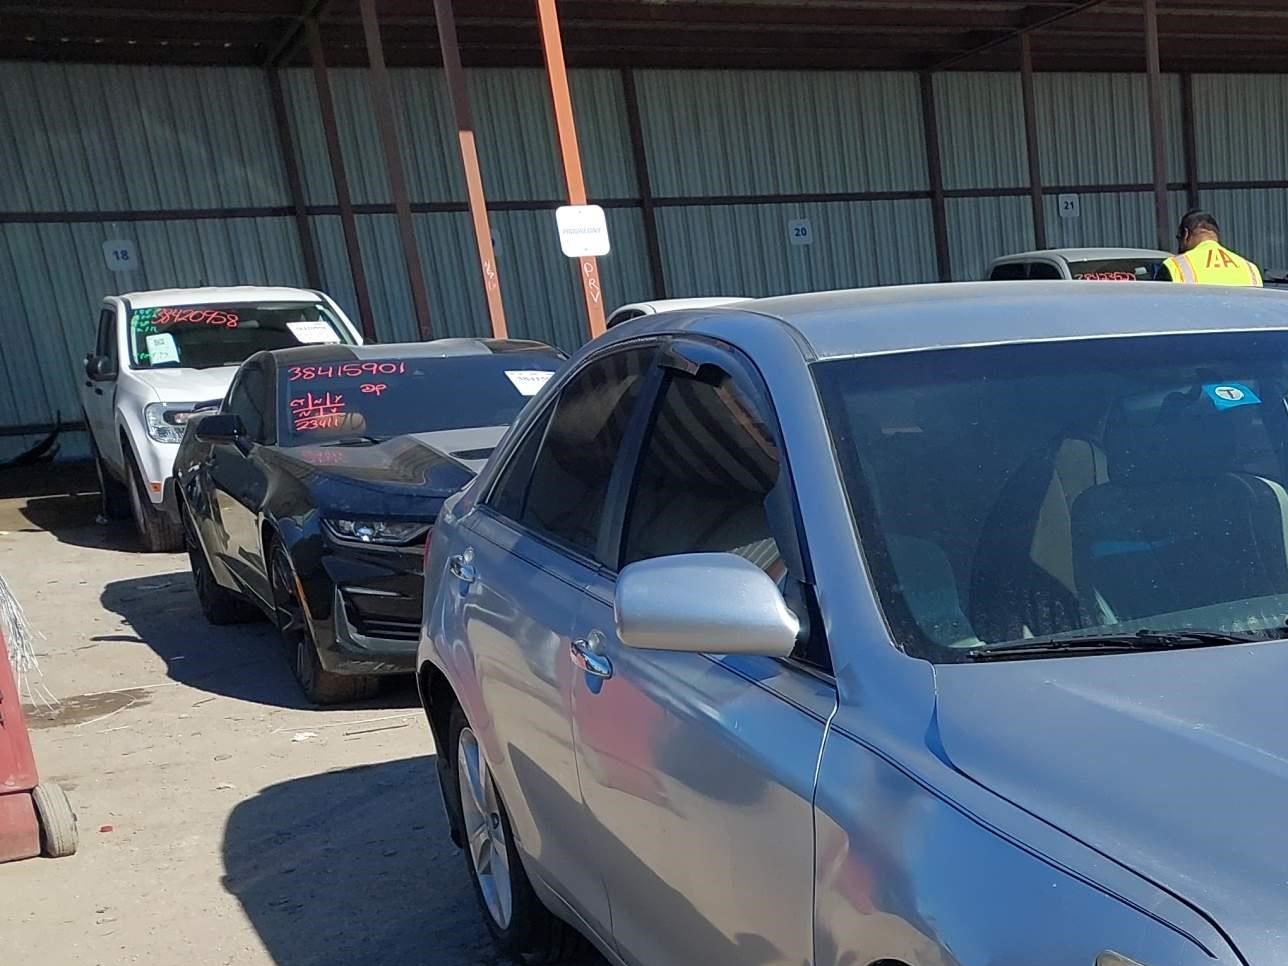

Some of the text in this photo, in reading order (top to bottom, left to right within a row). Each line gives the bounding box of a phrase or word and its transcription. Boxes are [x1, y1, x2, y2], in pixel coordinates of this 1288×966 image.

[1063, 200, 1074, 210] 21
[794, 227, 807, 237] 20
[112, 249, 129, 261] 18
[288, 362, 405, 381] 38415901
